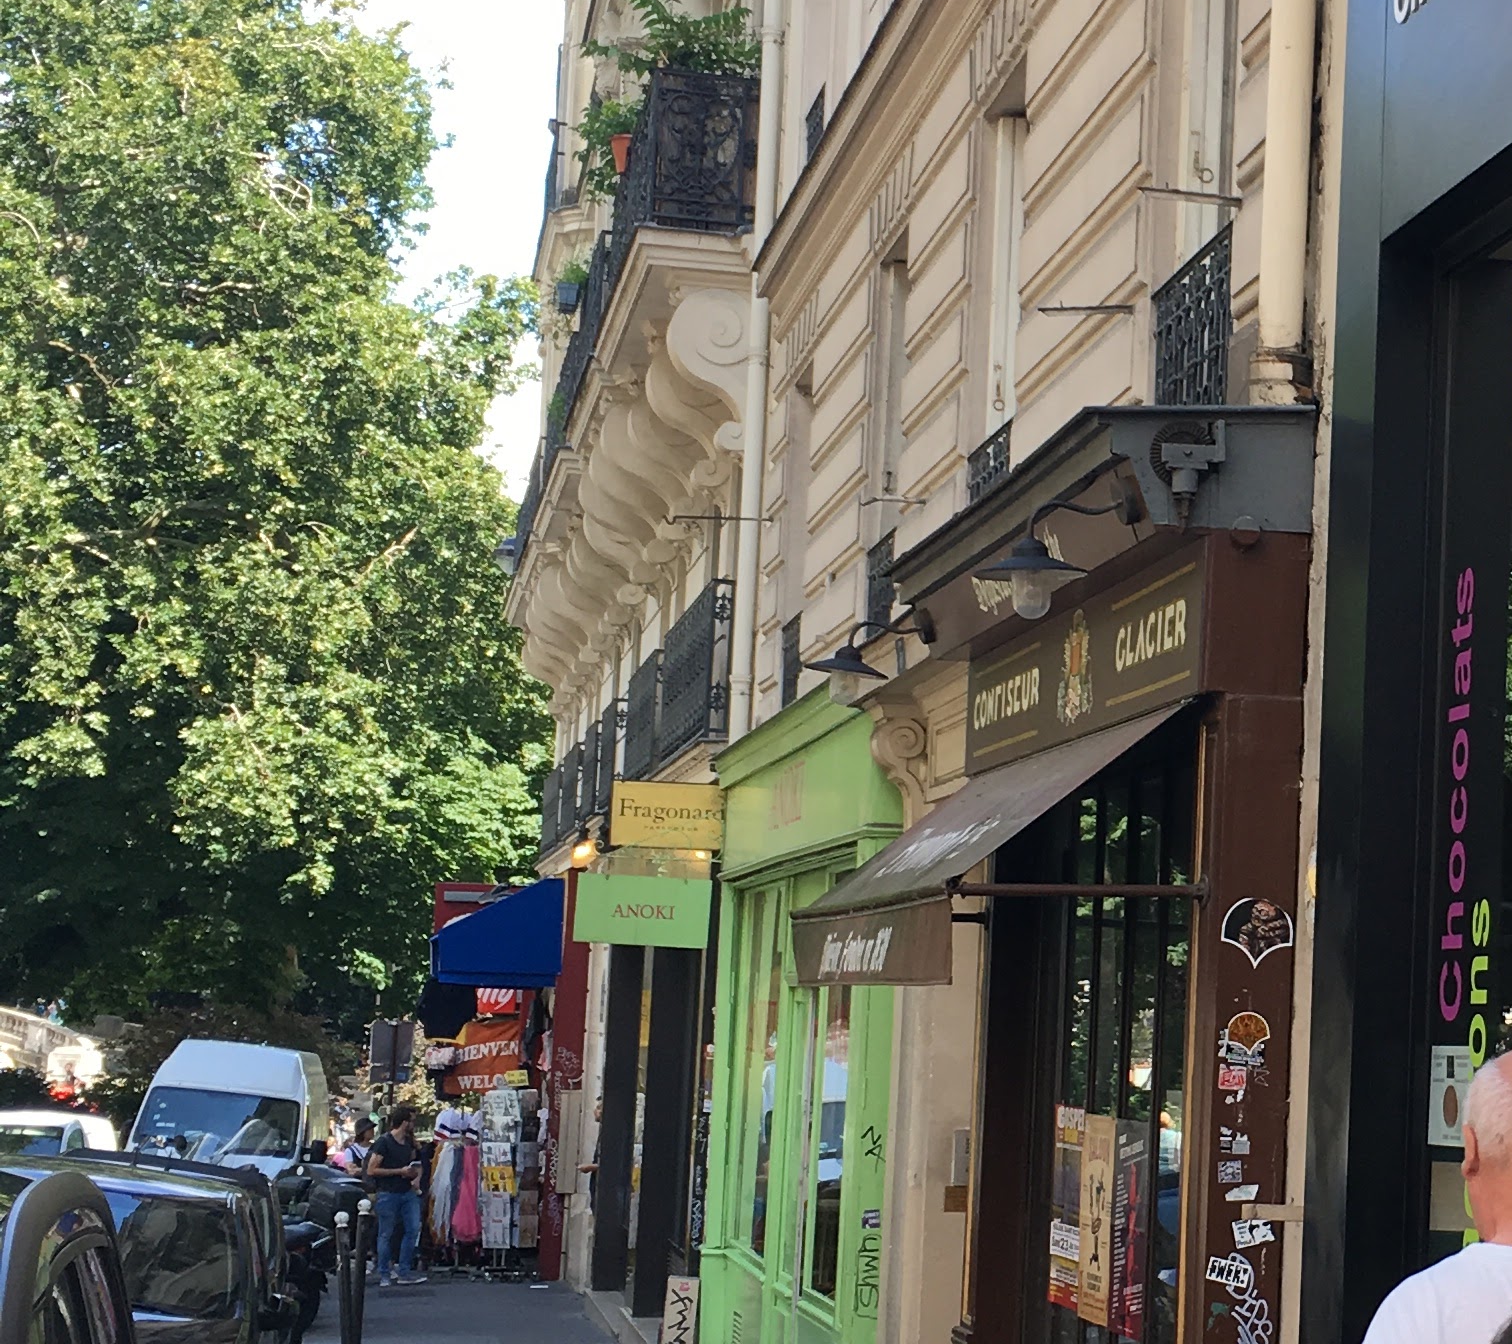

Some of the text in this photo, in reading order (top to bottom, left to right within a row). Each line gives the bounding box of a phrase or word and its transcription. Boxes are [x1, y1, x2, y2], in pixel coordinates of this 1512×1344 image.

[1115, 598, 1187, 672] GLACIER
[973, 667, 1040, 731] CONFISEUR
[1438, 566, 1476, 1022] Chocolats
[612, 903, 675, 920] ANOKI
